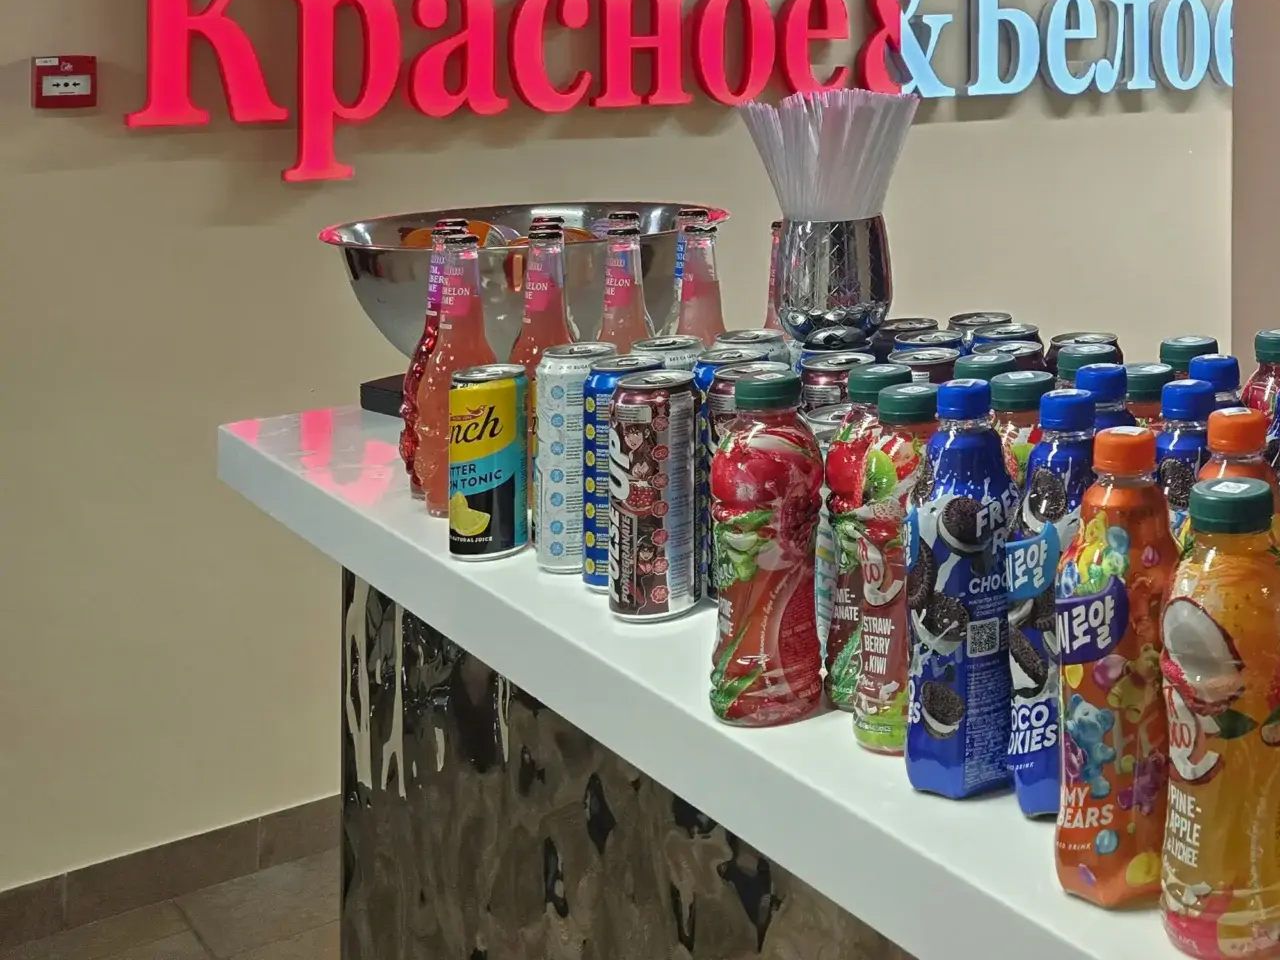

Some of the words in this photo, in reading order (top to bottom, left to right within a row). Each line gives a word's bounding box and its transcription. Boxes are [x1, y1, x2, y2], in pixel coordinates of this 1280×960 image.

[460, 469, 502, 489] TONIC
[620, 515, 632, 604] POMEGRANATE
[863, 615, 895, 636] STRAW-
[864, 635, 890, 654] BERRY
[869, 654, 887, 675] KIWI
[1170, 784, 1201, 818] PINE-
[1169, 810, 1201, 847] APPLE
[1172, 840, 1198, 868] LYCHEE
